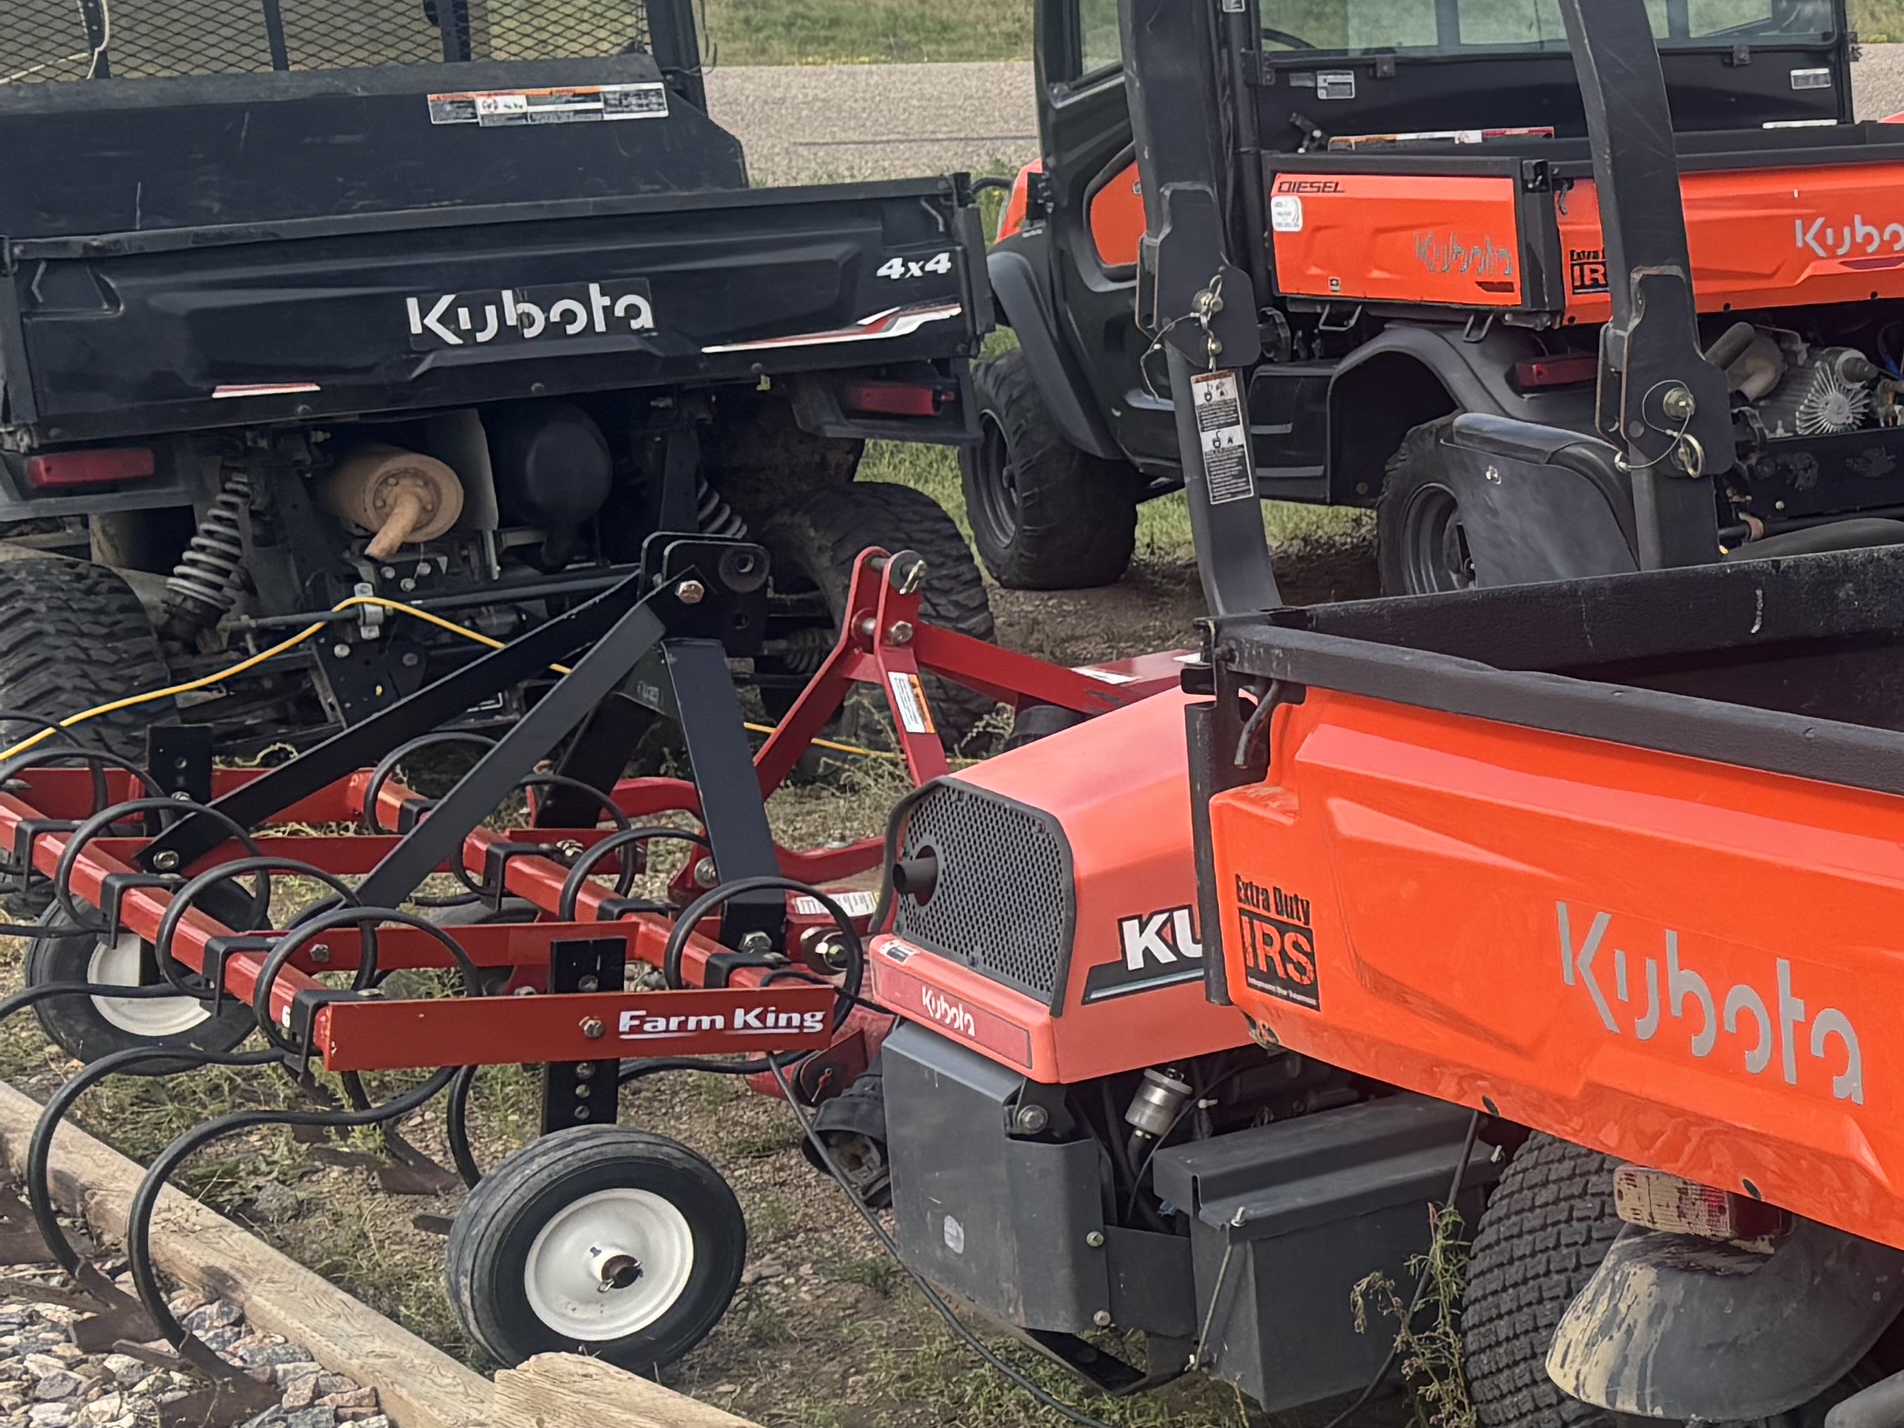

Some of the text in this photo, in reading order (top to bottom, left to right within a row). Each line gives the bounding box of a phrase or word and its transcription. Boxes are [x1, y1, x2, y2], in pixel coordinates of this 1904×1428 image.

[1278, 181, 1346, 193] DIESEL
[876, 251, 952, 281] 4x4
[1414, 231, 1514, 277] Kubota
[406, 282, 656, 346] Kubota
[1235, 873, 1310, 927] Extra Duty
[1241, 915, 1315, 986] IRS
[618, 1006, 825, 1034] Farm King
[921, 986, 976, 1037] Kubota
[1556, 900, 1864, 1105] Kubota
